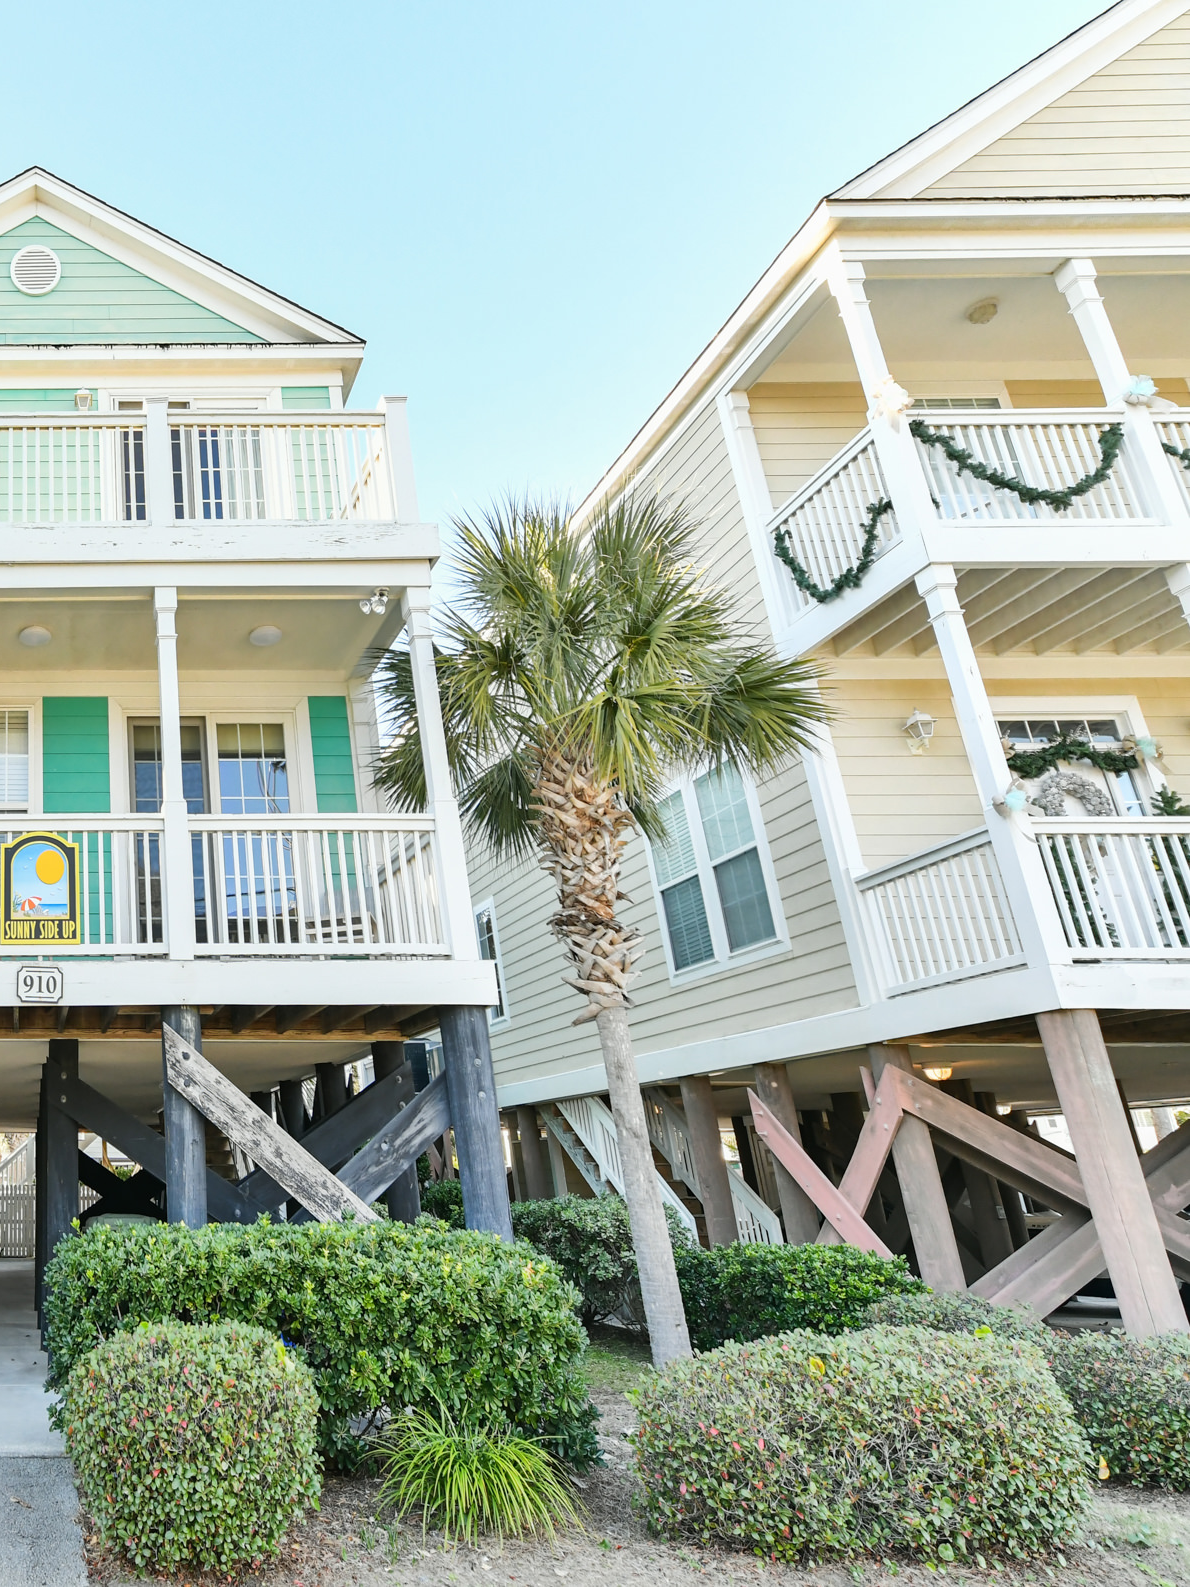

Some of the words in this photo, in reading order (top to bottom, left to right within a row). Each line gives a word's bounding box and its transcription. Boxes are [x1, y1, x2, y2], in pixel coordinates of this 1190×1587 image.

[5, 921, 36, 939] SUNNY
[39, 921, 59, 939] SIDE
[62, 921, 76, 939] UP
[23, 974, 57, 994] 910
